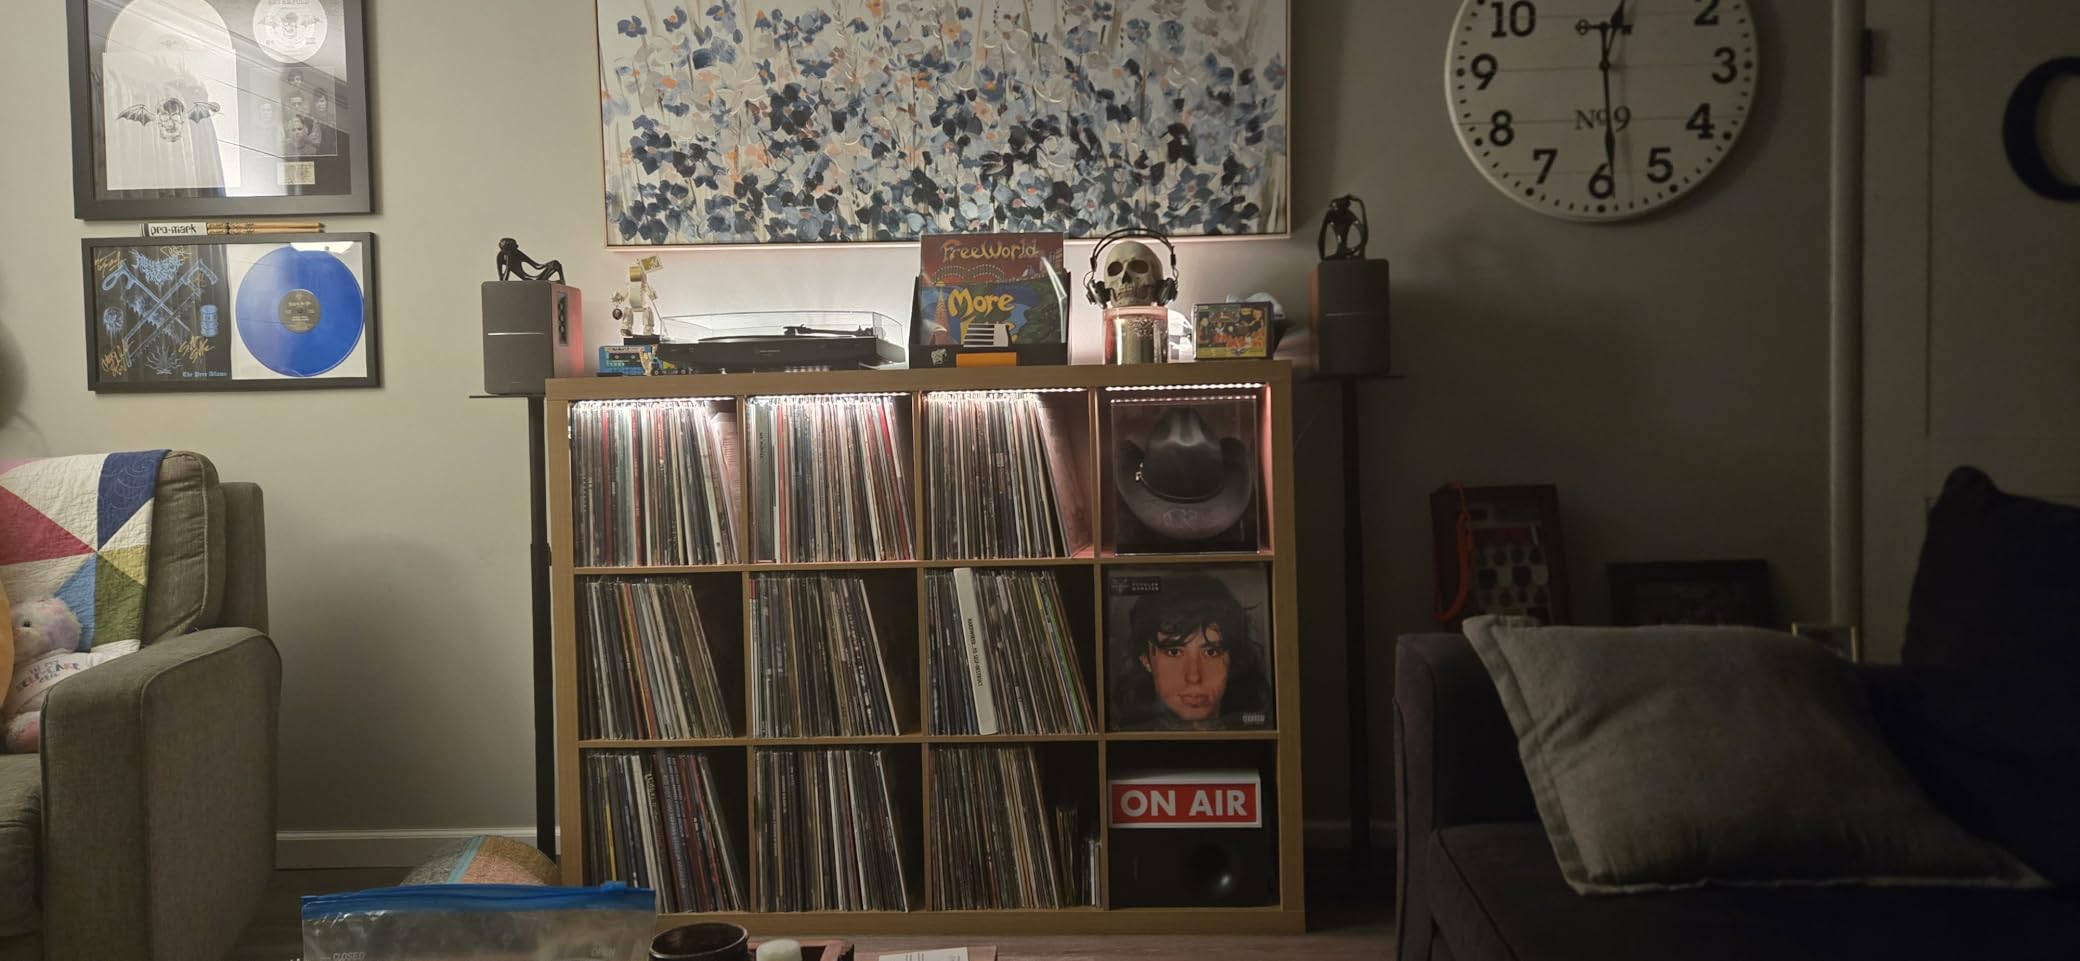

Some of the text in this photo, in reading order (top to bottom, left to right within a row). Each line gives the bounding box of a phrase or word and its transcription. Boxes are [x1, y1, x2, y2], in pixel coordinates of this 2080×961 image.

[1491, 1, 1536, 37] 10
[1694, 0, 1719, 26] 2
[1470, 54, 1498, 90] 9
[1711, 47, 1738, 84] 3
[1489, 110, 1514, 147] 8
[1685, 103, 1715, 140] 4
[1533, 149, 1558, 184] 7
[1588, 164, 1614, 199] 6
[1647, 147, 1674, 183] 5
[948, 287, 1016, 320] More
[1120, 790, 1248, 817] ON AIR
